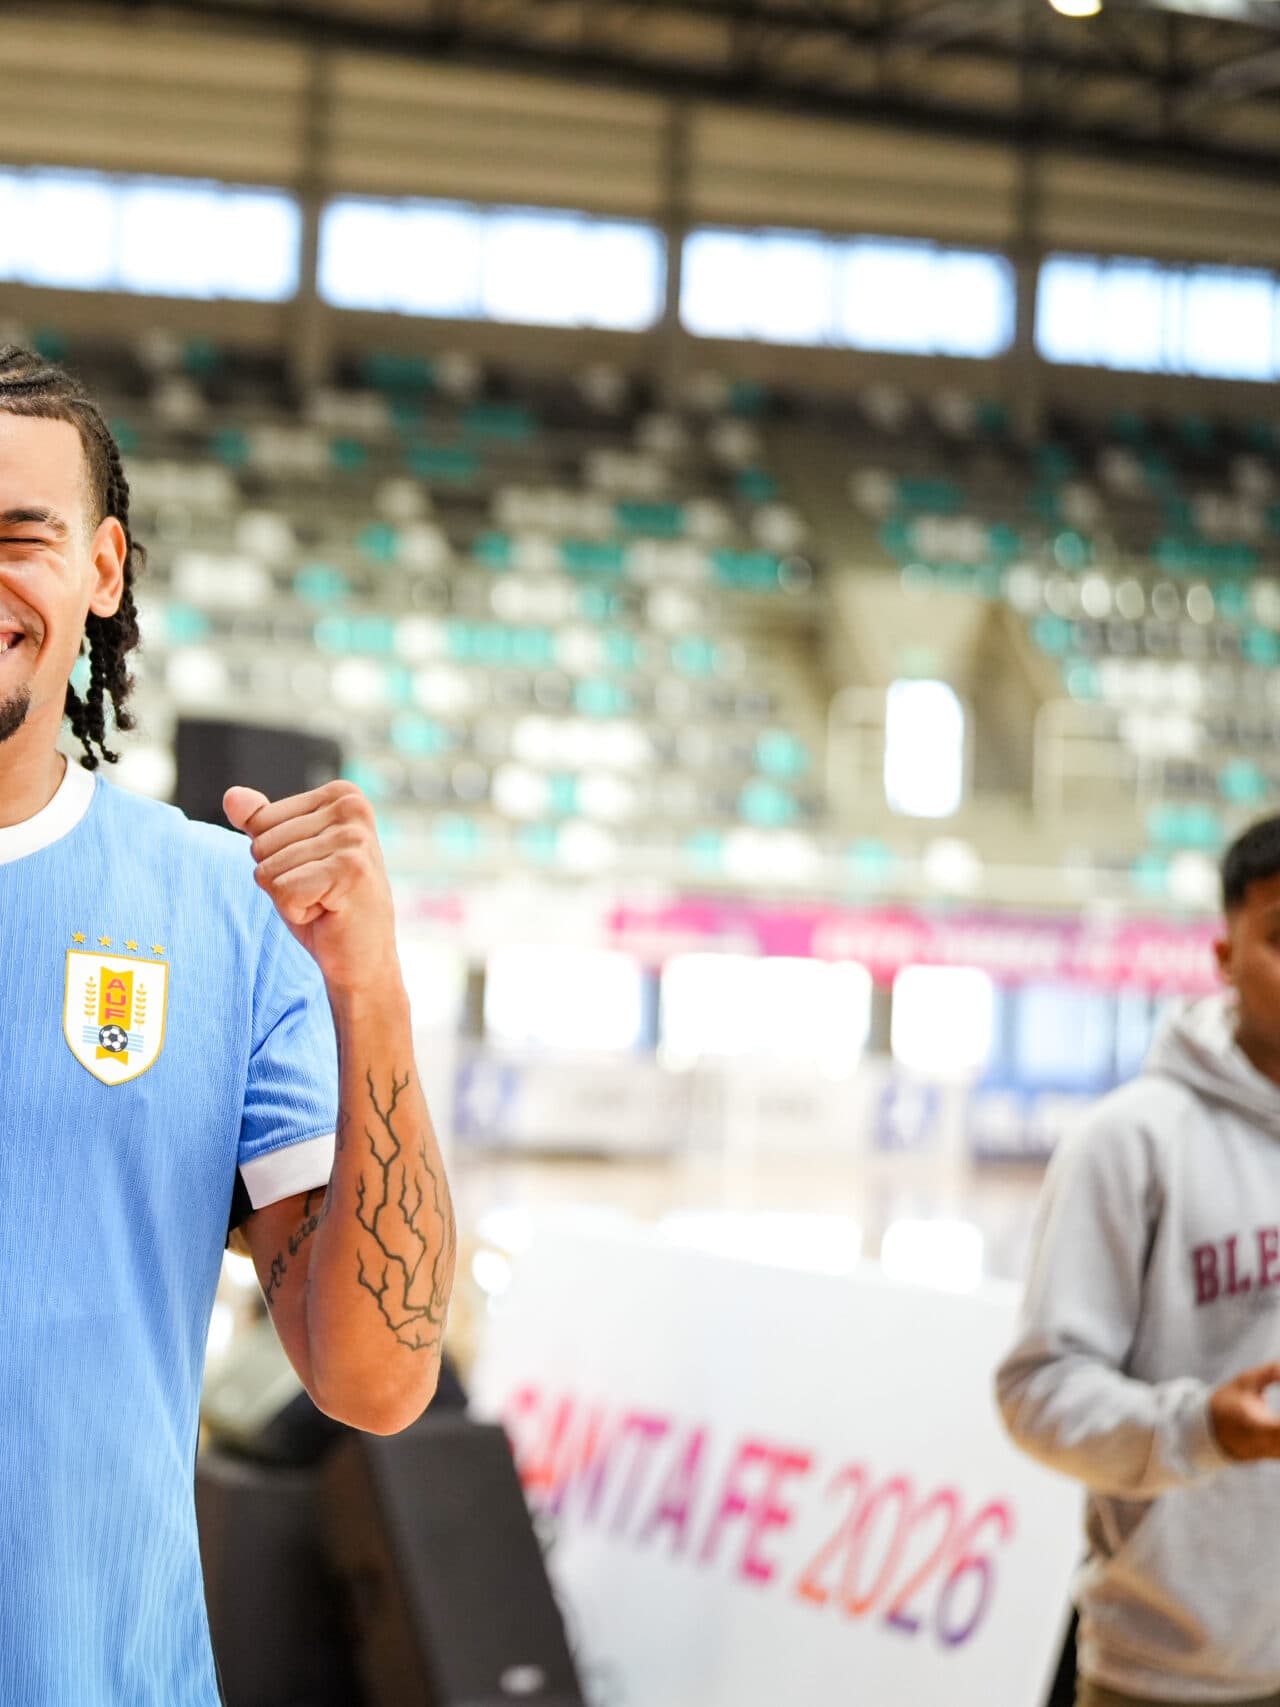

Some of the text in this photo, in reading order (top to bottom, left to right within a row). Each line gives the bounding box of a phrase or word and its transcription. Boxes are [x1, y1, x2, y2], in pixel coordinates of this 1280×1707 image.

[104, 977, 127, 1021] AUF
[698, 1440, 812, 1592] FE
[793, 1460, 1014, 1652] 2026
